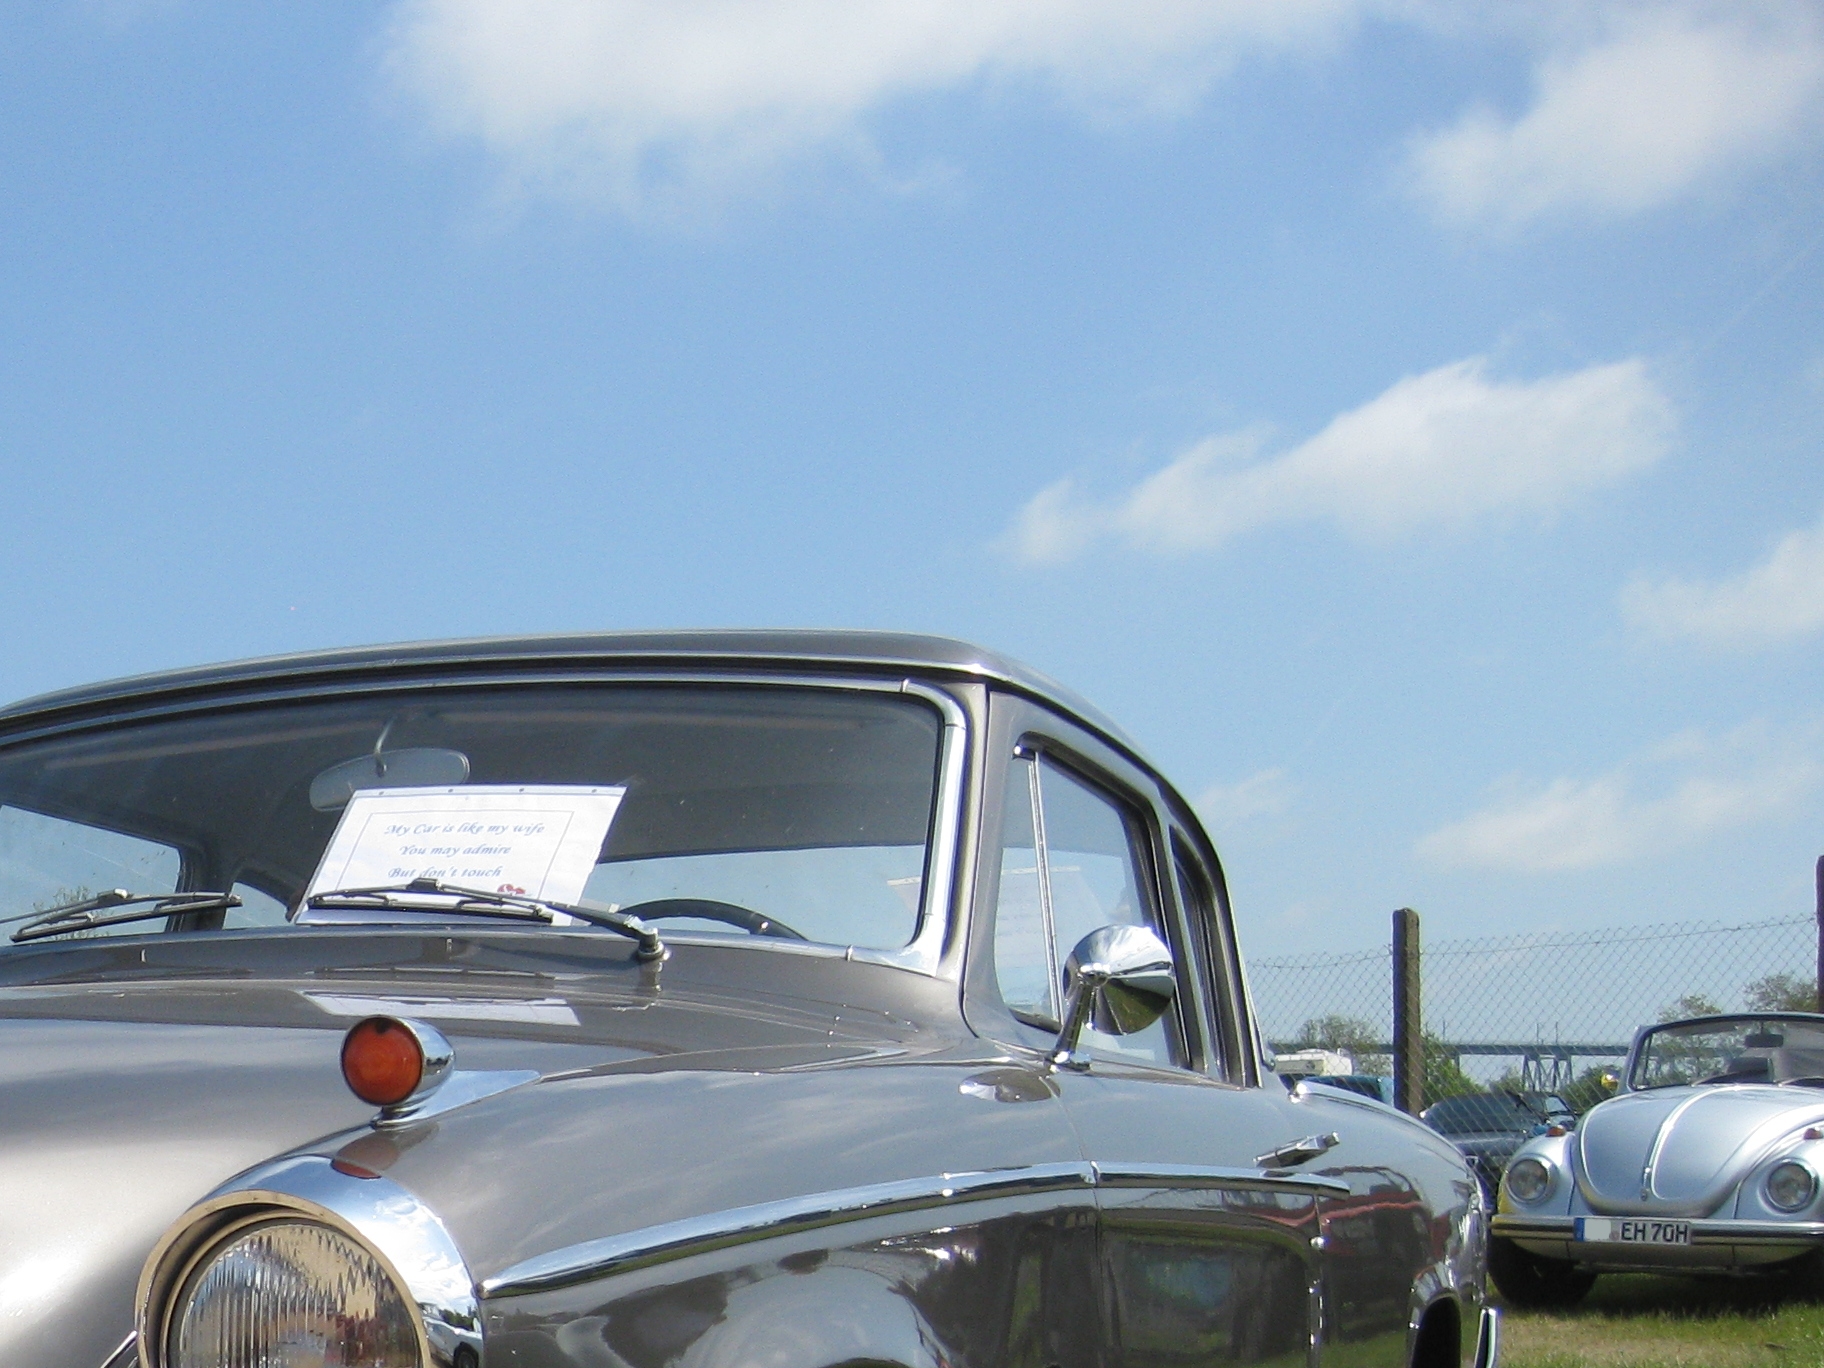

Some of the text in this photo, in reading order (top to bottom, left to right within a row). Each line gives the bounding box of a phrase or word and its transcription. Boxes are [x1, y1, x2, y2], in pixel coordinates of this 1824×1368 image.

[384, 822, 545, 836] My Car is like my wife
[399, 843, 512, 858] You may admire
[388, 866, 503, 878] But don't touch
[1621, 1222, 1646, 1242] EH
